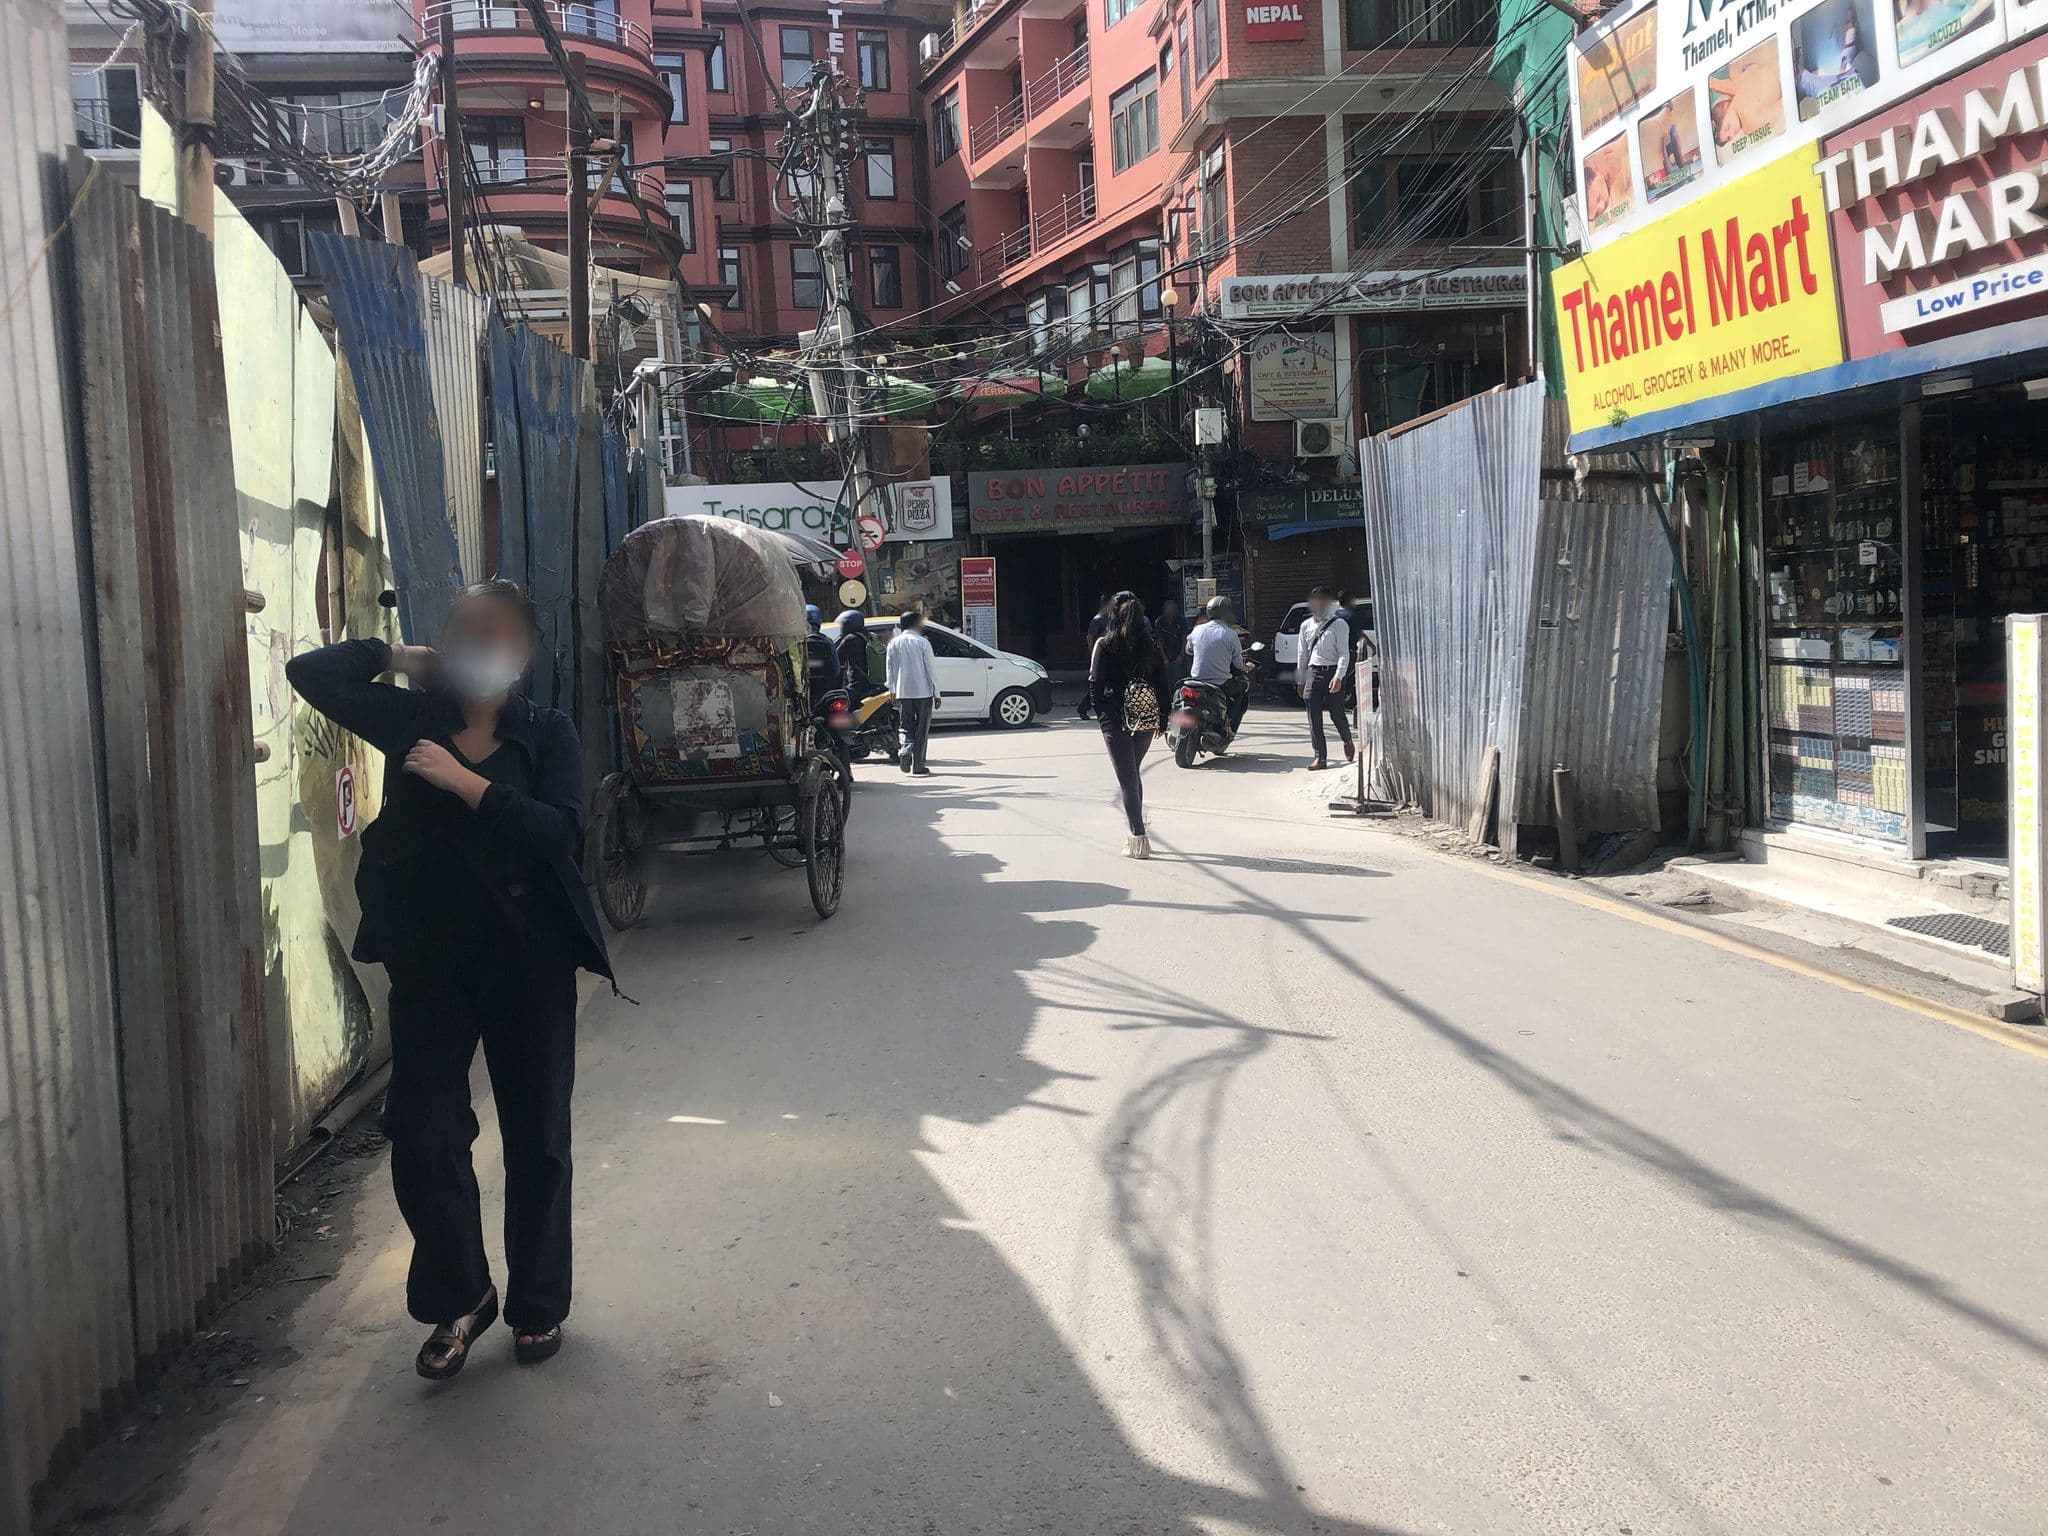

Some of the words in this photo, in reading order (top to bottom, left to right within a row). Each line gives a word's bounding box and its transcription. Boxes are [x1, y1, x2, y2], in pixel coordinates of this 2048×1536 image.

[1246, 4, 1303, 25] NEPAL
[827, 0, 845, 77] TEL
[1682, 18, 1733, 71] Thamel,
[1927, 17, 1962, 49] JACUZZI
[1840, 75, 1861, 97] BATH
[1732, 136, 1747, 154] DEEP
[1749, 123, 1772, 144] TISSUE
[1864, 158, 2048, 286] MAR
[1229, 284, 1269, 303] BON
[1562, 235, 1697, 374] Thamel
[1701, 195, 1819, 328] Mart
[1916, 290, 1965, 317] Low
[1972, 267, 2045, 301] Price
[1255, 340, 1278, 362] BON
[1593, 380, 1642, 411] ALCOHOL,
[1643, 363, 1694, 394] GROCERY
[1699, 361, 1708, 380] &
[1710, 348, 1747, 377] MANY
[987, 476, 1047, 501] BON
[702, 501, 826, 530] Trisara
[907, 509, 931, 521] PIZZA
[1031, 504, 1049, 521] &
[838, 559, 863, 570] STOP
